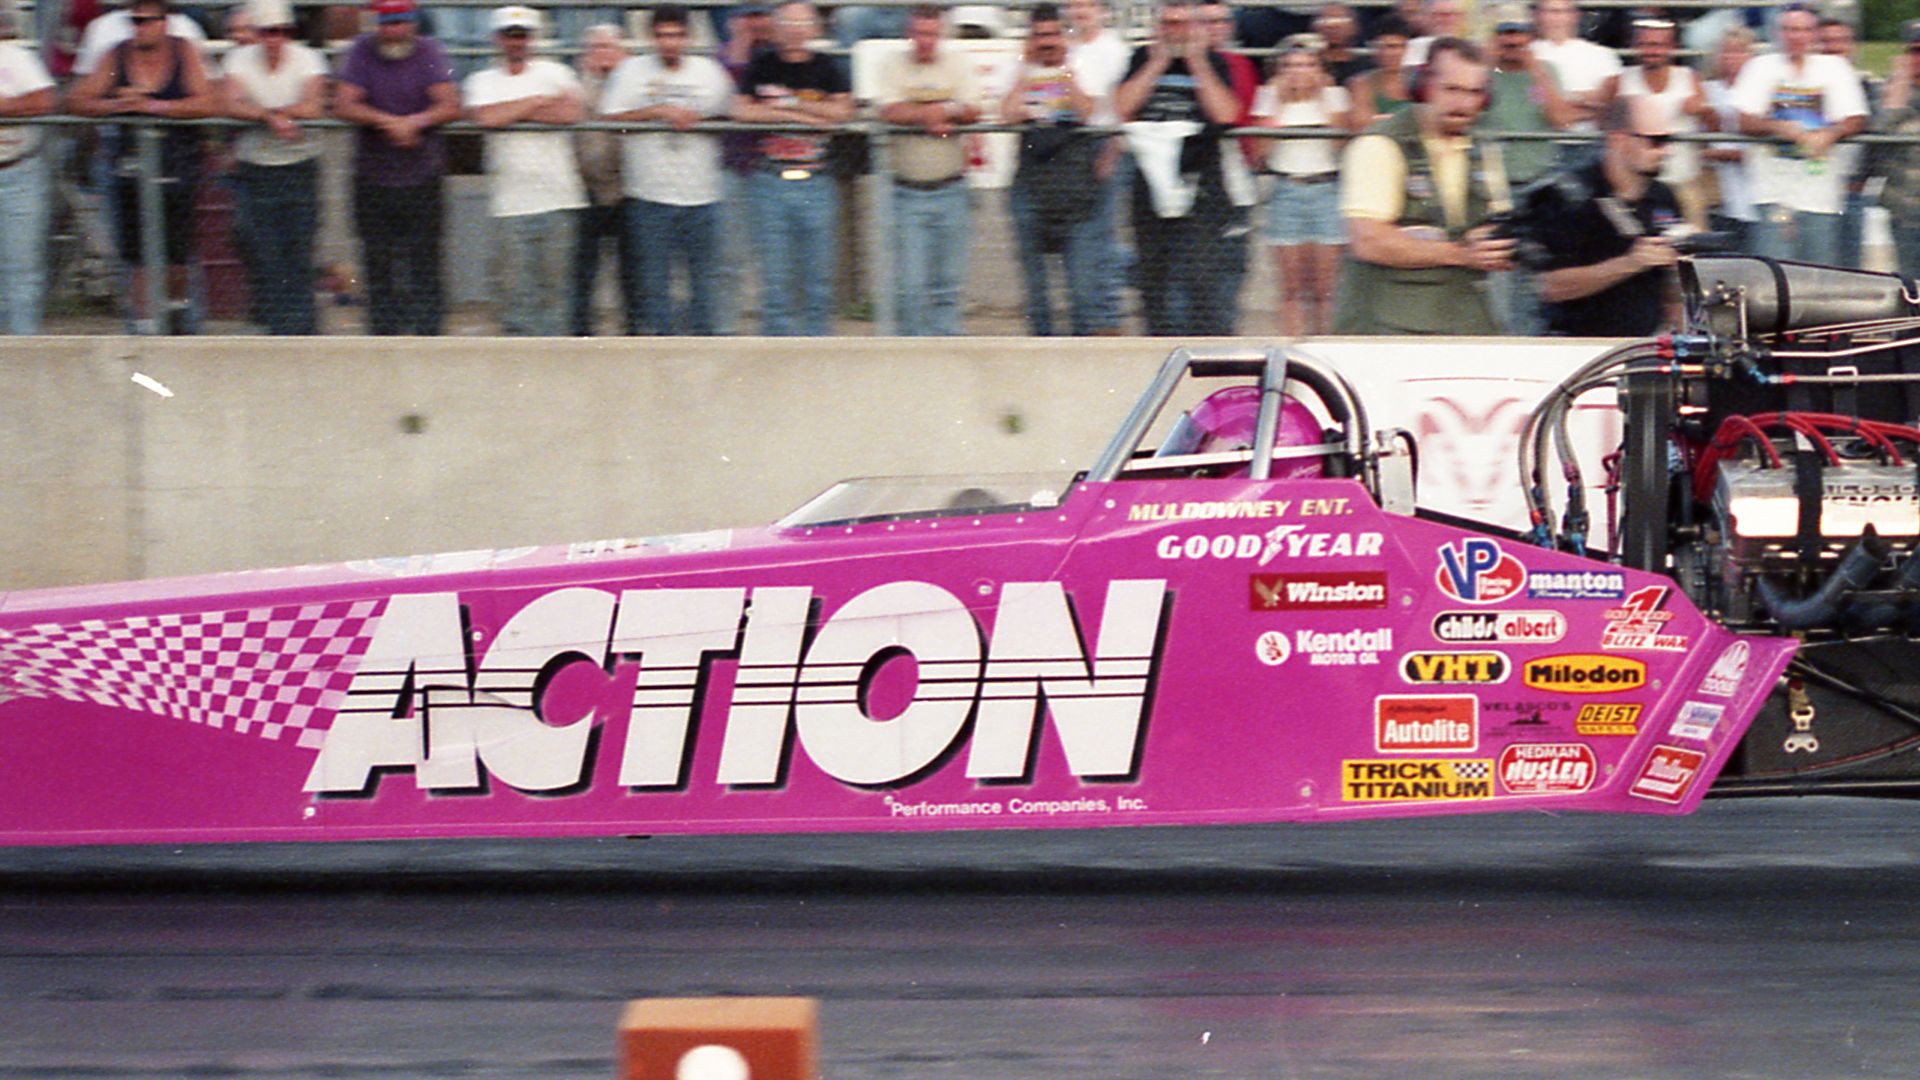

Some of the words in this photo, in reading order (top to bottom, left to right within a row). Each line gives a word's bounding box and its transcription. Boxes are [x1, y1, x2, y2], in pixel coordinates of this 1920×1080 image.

[1128, 500, 1291, 521] MULDOWNEY
[1299, 498, 1353, 516] ENT.
[1156, 527, 1384, 560] GOODYEAR
[1438, 538, 1502, 600] VP
[1529, 571, 1623, 590] manton
[1286, 581, 1384, 602] Winston
[1504, 616, 1558, 637] albert
[1296, 628, 1392, 653] Kendall
[1602, 634, 1646, 647] BLITZ
[1653, 635, 1688, 648] WAX
[1311, 653, 1356, 665] MOTOR
[1411, 654, 1499, 681] VHT
[1530, 664, 1640, 683] Milodon
[303, 579, 1169, 794] ACTION
[1580, 706, 1638, 722] DEIST
[1384, 719, 1470, 743] Autolite
[1515, 746, 1581, 758] HEDMAN
[1348, 763, 1443, 780] TRICK
[1348, 781, 1488, 799] TITANIUM
[891, 801, 1001, 816] Performance
[1008, 797, 1112, 815] Companies,
[1117, 796, 1148, 811] Inc.
